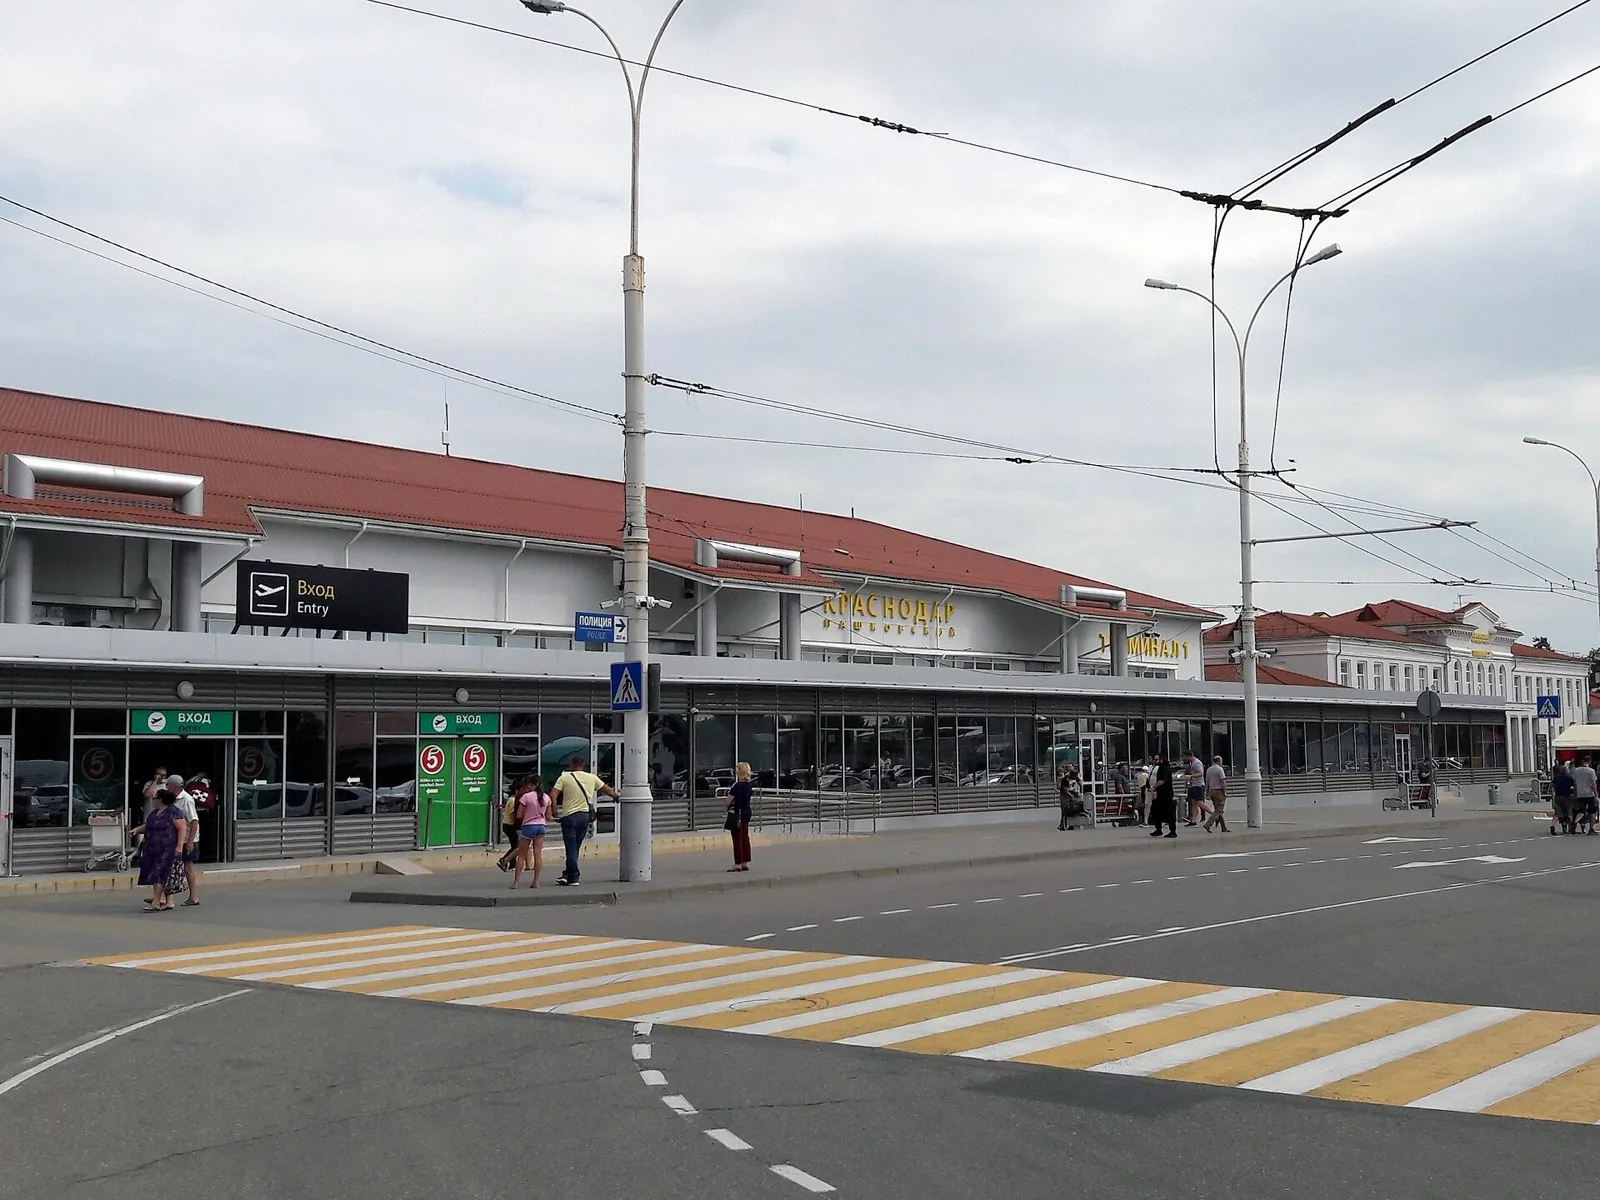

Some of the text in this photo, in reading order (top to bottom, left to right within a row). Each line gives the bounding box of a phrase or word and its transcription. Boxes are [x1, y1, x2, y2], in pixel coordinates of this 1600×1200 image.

[297, 580, 335, 600] Вход
[297, 602, 329, 617] Entry
[823, 592, 955, 625] КРАСНОДАР
[579, 615, 612, 628] ПОЛИЦИЯ
[1098, 632, 1179, 658] ТМИНАЛ
[178, 713, 211, 724] ВХОД
[456, 715, 482, 725] ВХОД
[90, 750, 104, 774] 5
[426, 747, 440, 769] 5
[469, 745, 482, 768] 5
